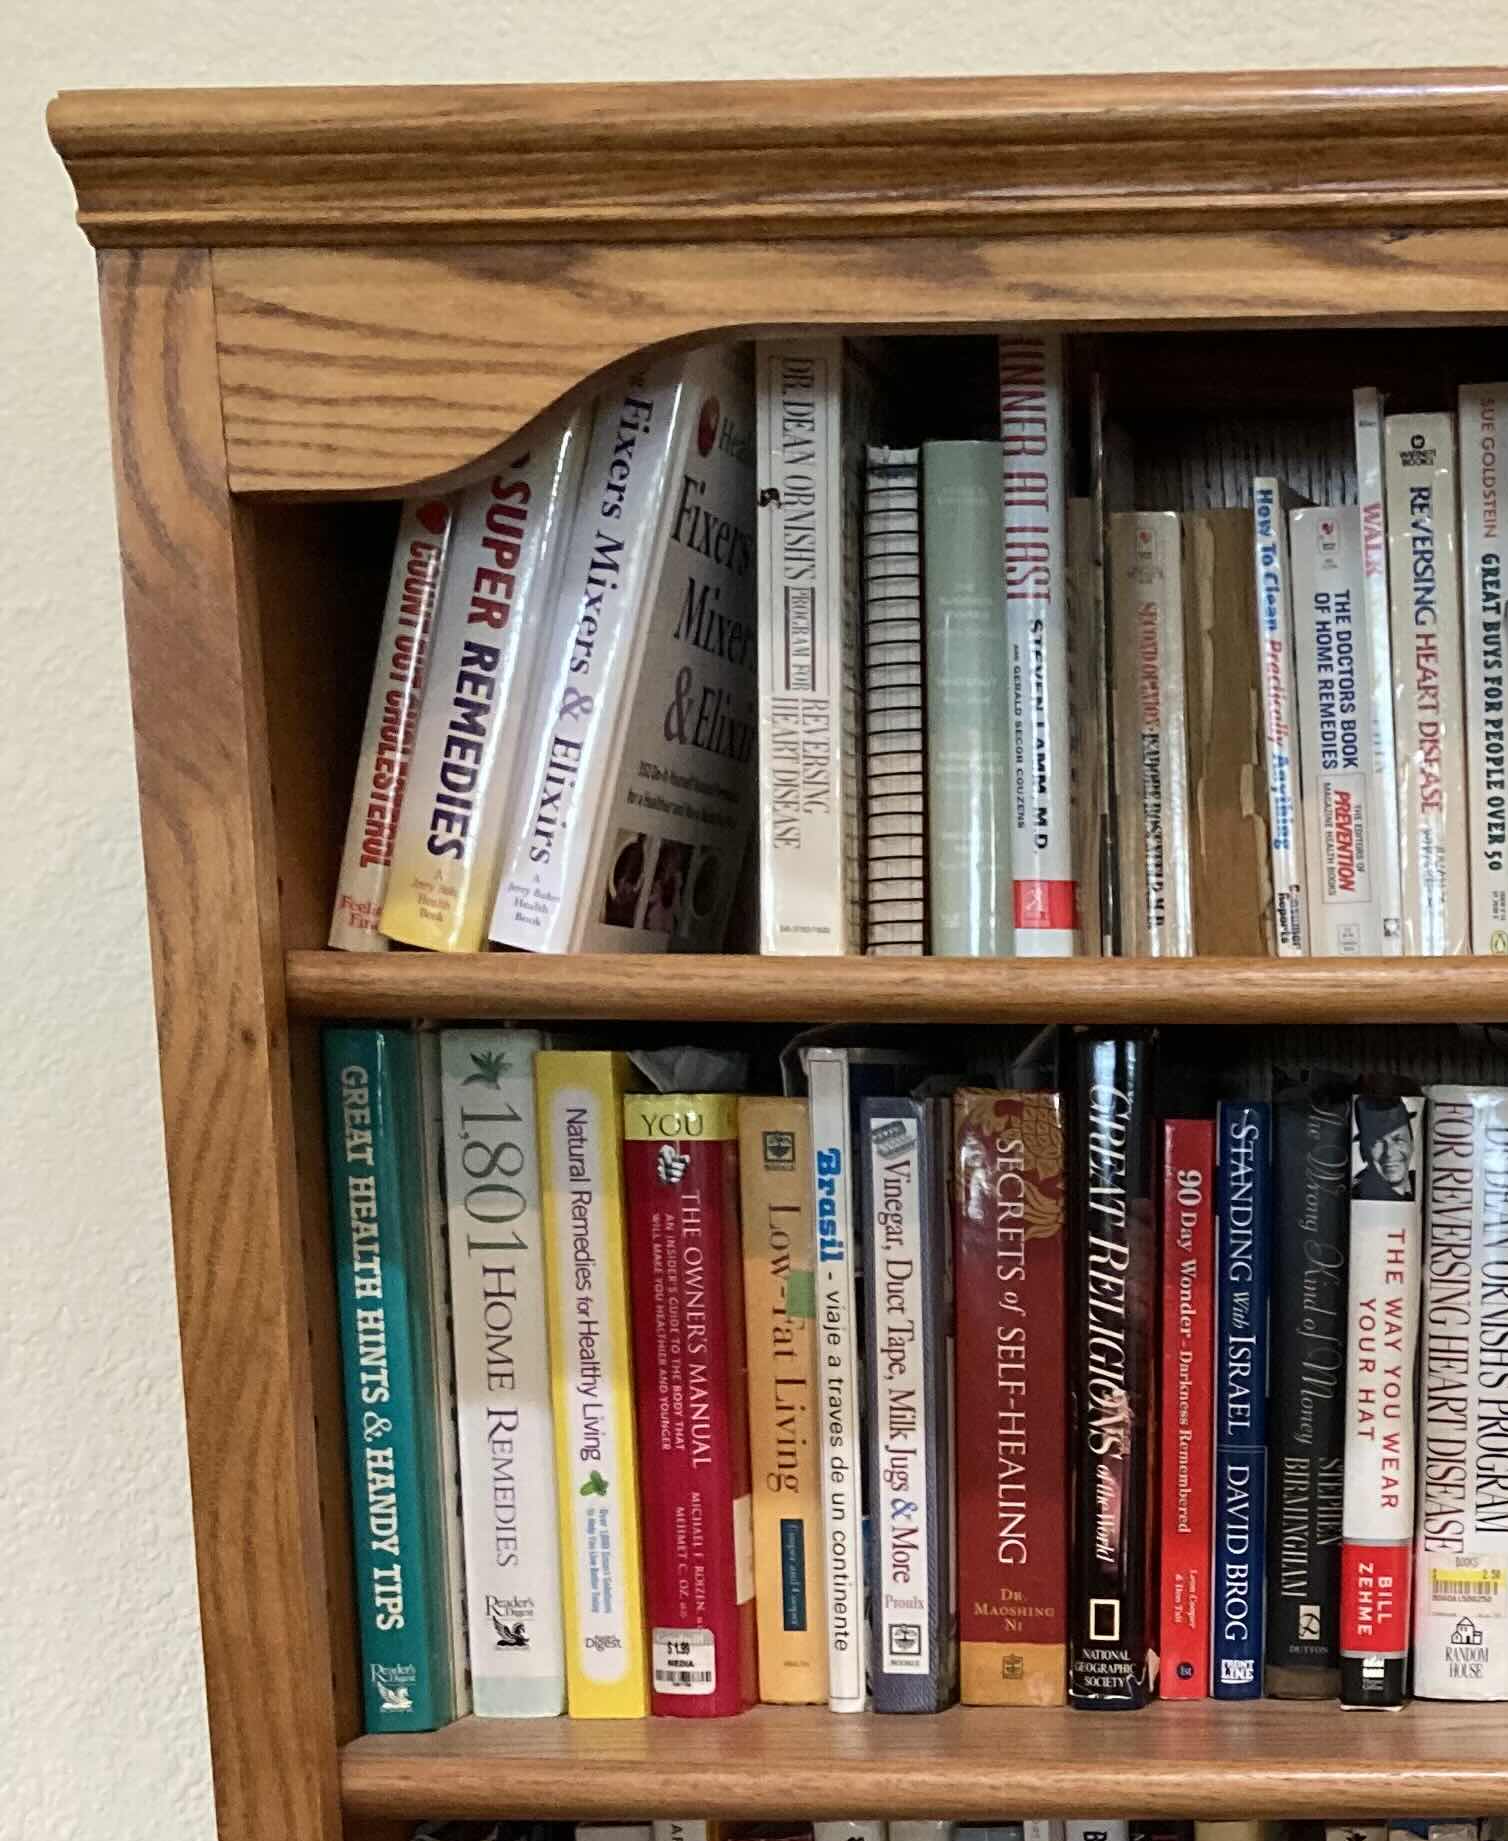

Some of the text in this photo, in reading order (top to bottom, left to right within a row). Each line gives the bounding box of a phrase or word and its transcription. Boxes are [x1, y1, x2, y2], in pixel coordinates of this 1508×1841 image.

[427, 478, 532, 861] SUPER REMEDIES
[529, 393, 654, 864] Fixers Mixers & Elixirs
[1315, 591, 1338, 769] OF HOME REMEDIES
[1335, 589, 1359, 769] THE DOCTORS BOOK
[1481, 554, 1506, 872] GREAT BUYS FOR PEOPLE OVER 50
[1335, 790, 1355, 892] PREVENTION
[641, 1113, 703, 1137] YOU
[816, 1148, 845, 1264] Brasil
[339, 1064, 404, 1632] GREAT HEALTH HINTS & HANDY TIPS
[460, 1104, 528, 1570] 1,801 HOME REMEDIES
[823, 1291, 842, 1346] viaje
[828, 1354, 841, 1365] a
[879, 1159, 919, 1583] Vinegar, Duct Tape, Milk Jugs & More
[1358, 1298, 1378, 1441] YOUR HAT
[1379, 1230, 1406, 1508] THE WAY YOU WEAR
[827, 1376, 844, 1449] traves
[829, 1455, 846, 1483] de
[832, 1493, 847, 1519] un
[1222, 1464, 1250, 1642] DAVID BROG
[831, 1529, 848, 1654] continente
[1356, 1560, 1375, 1637] ZEHME
[1378, 1576, 1393, 1623] BILL
